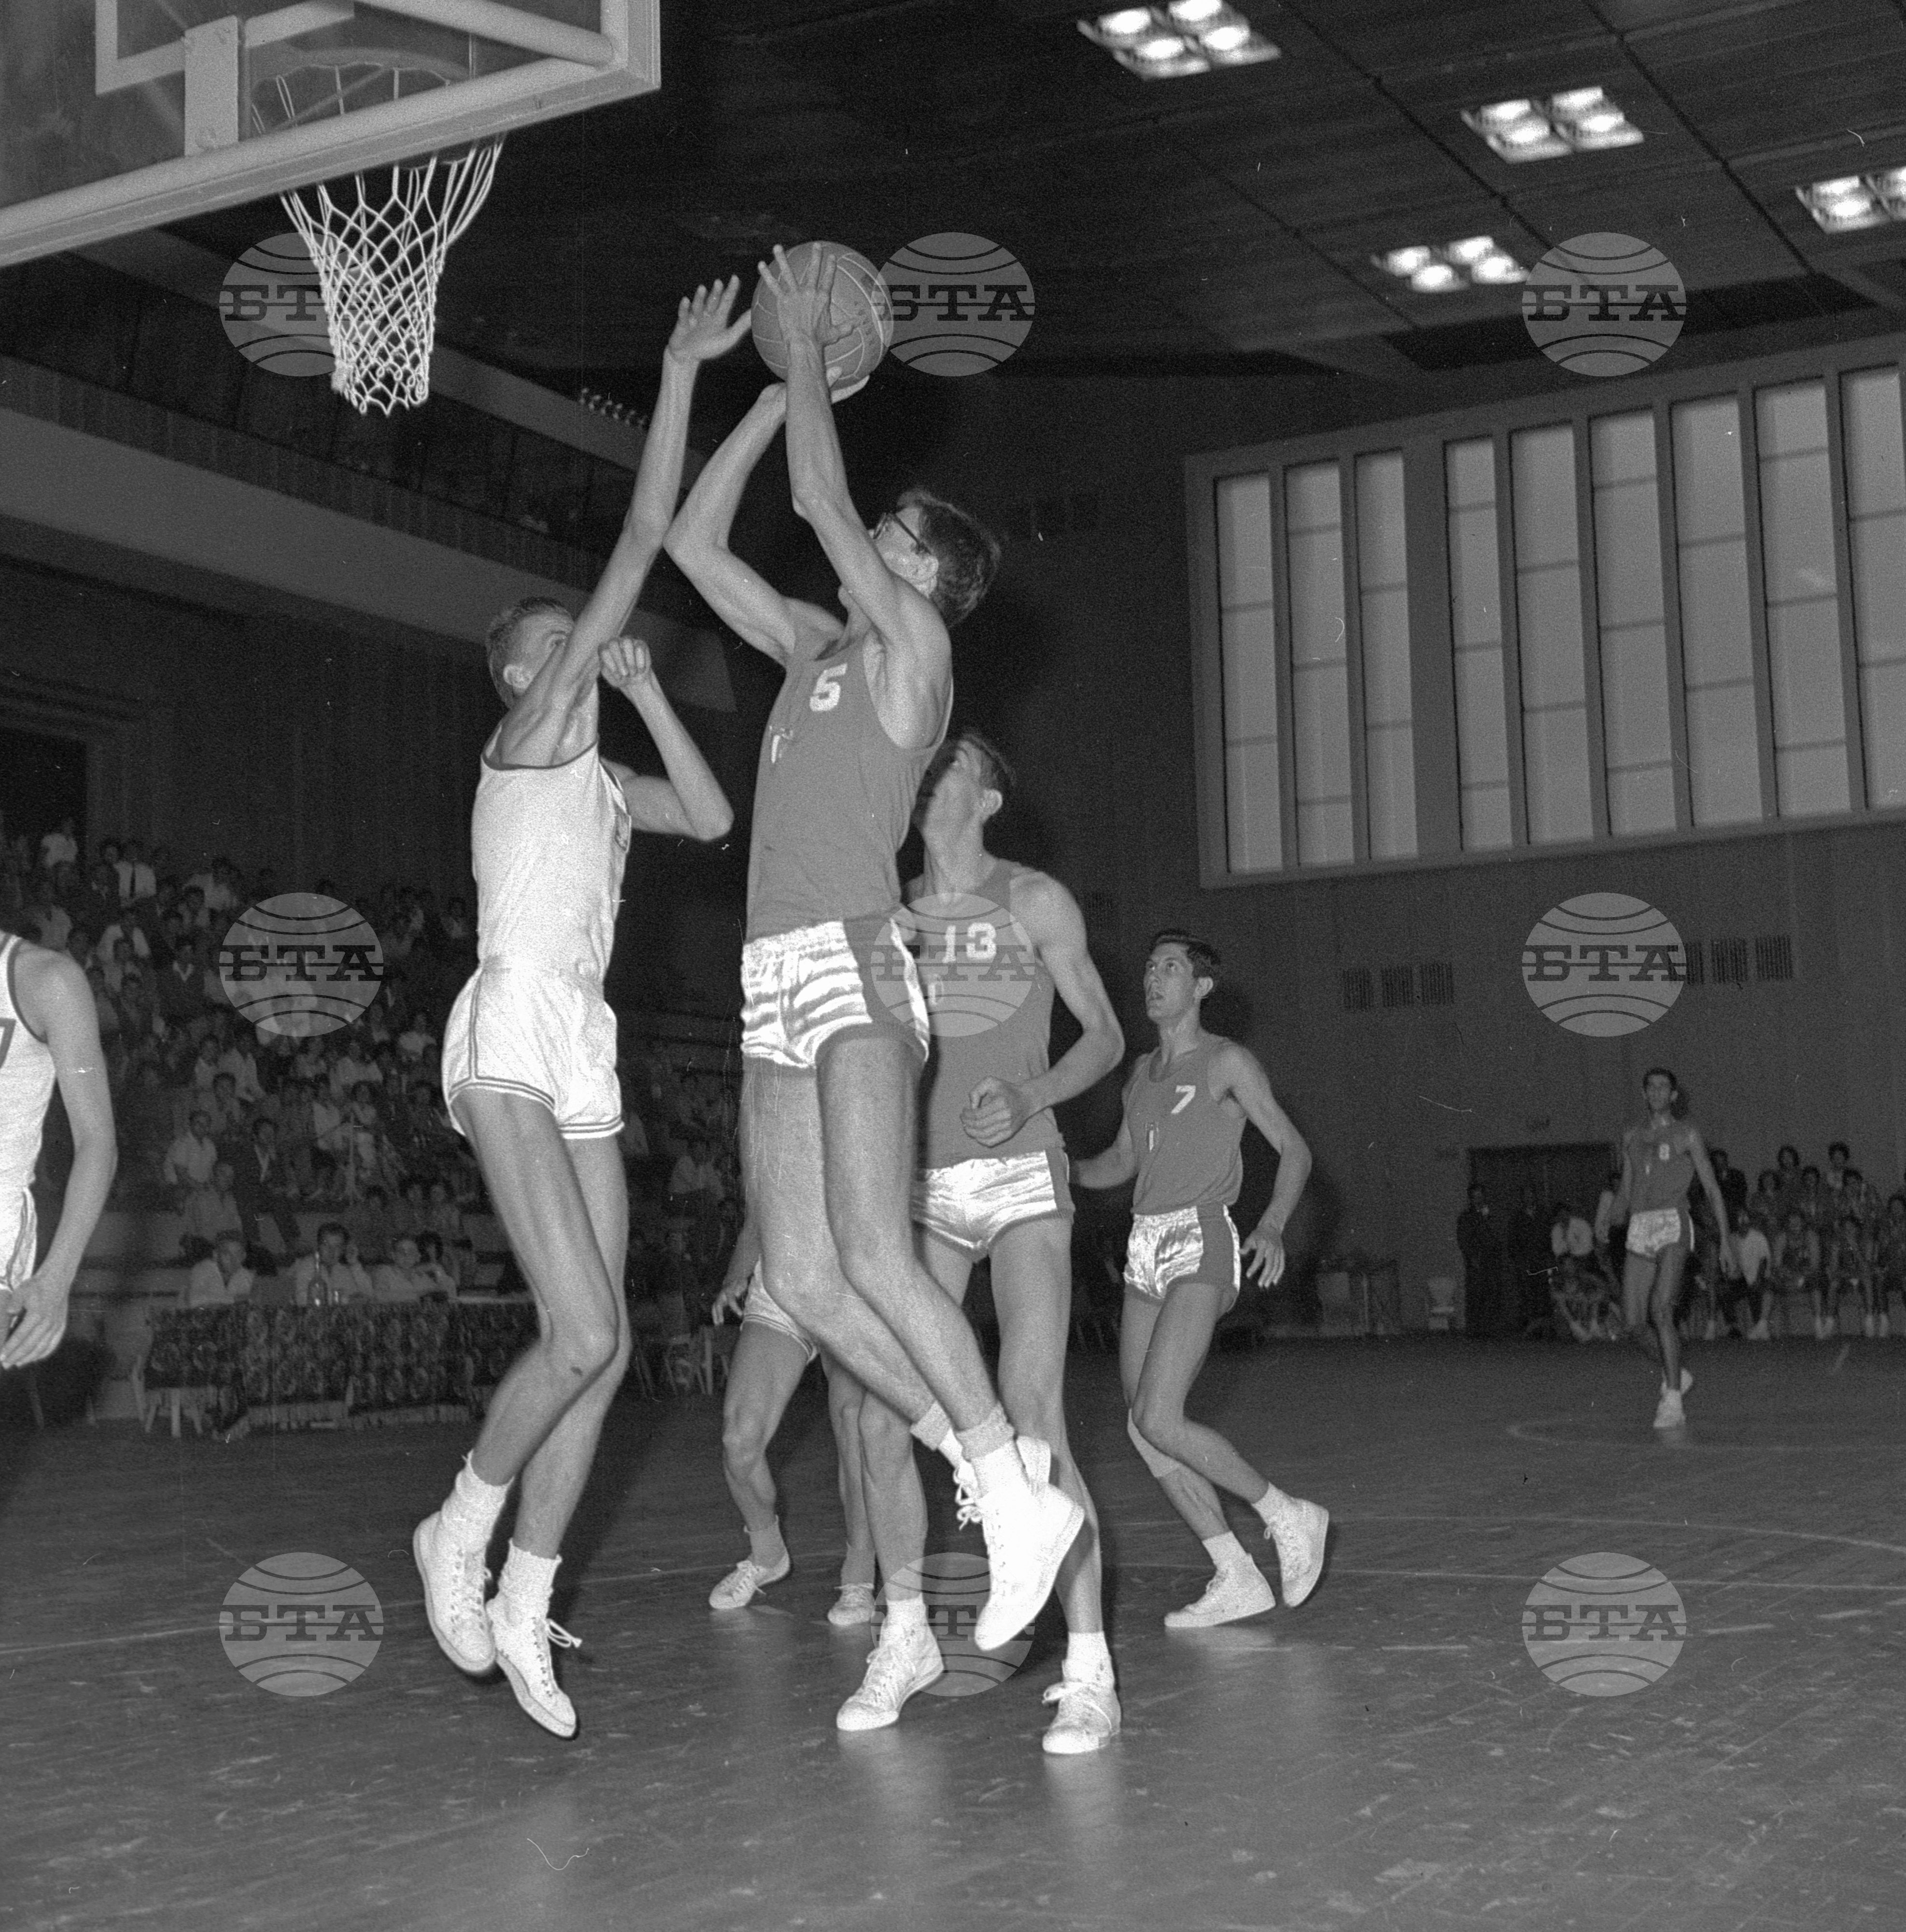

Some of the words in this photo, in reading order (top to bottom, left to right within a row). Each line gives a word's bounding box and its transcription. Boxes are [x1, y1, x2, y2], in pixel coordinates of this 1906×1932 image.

[809, 663, 847, 711] 5
[942, 922, 997, 964] 13
[1171, 1085, 1196, 1114] 7
